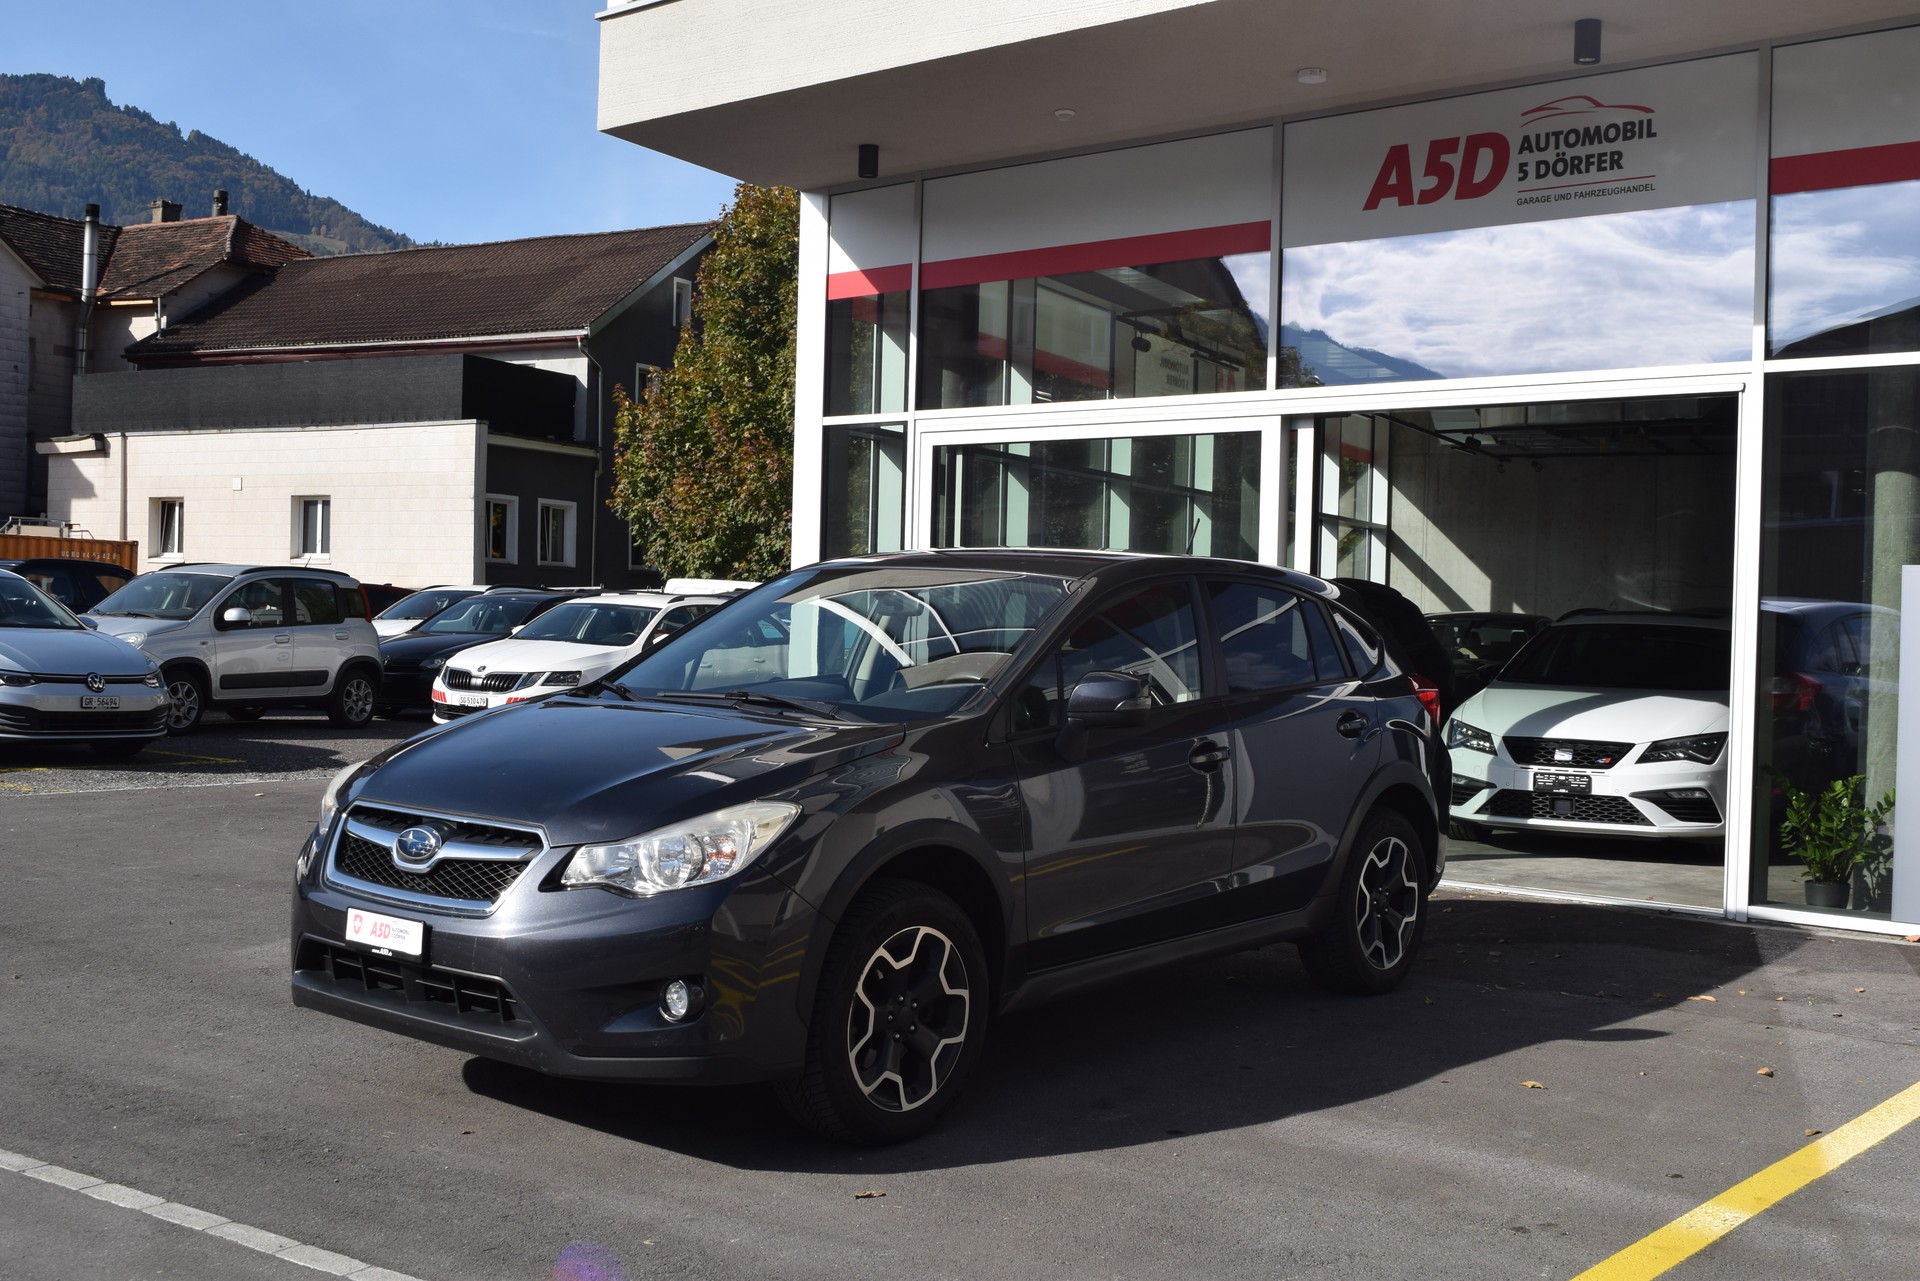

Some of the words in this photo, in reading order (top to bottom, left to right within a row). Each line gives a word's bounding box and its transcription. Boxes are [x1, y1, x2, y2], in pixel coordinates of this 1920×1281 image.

[1517, 118, 1657, 155] AUTOMOBIL
[1362, 132, 1511, 211] A5D
[1517, 162, 1529, 182] 5
[1535, 151, 1624, 180] DÖRFER
[1516, 194, 1552, 206] GARAGE
[1553, 191, 1573, 203] UND
[1573, 183, 1656, 200] FAHRZEUGHANDEL
[370, 921, 391, 940] A5D
